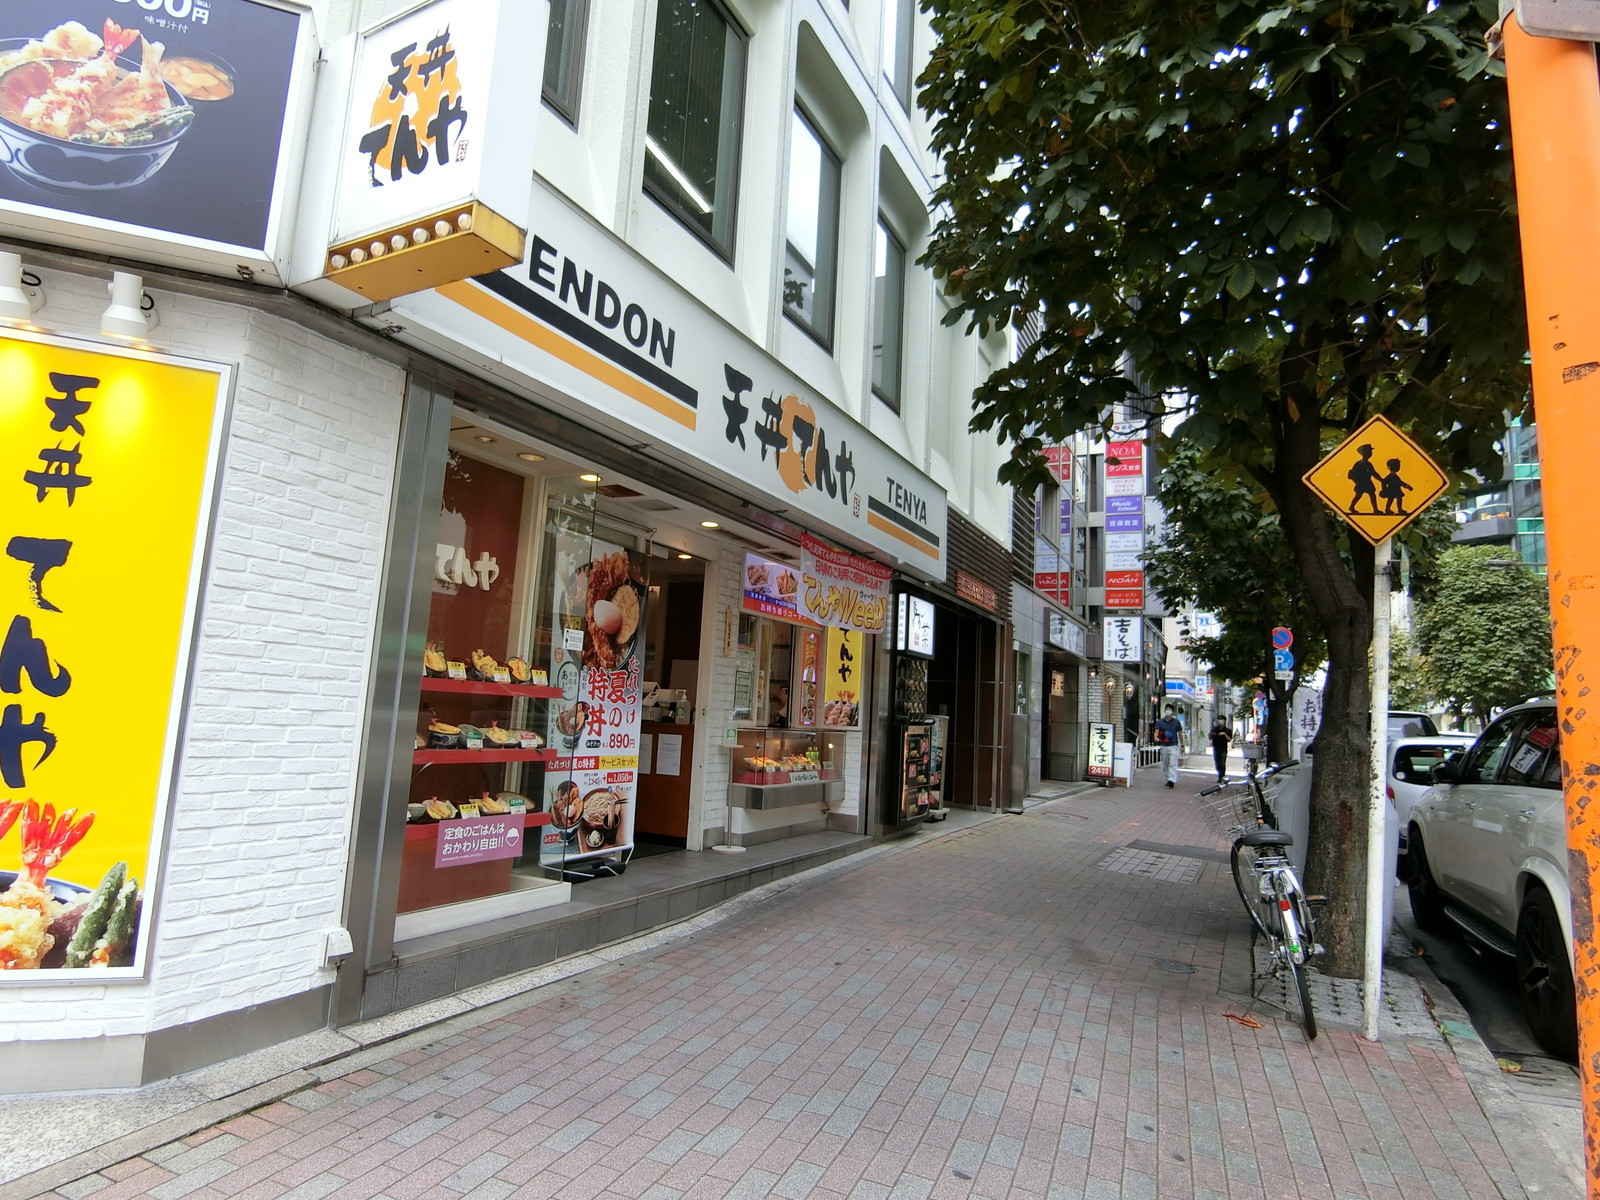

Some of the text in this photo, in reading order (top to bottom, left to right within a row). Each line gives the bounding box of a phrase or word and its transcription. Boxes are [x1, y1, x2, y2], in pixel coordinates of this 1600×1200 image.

[144, 15, 189, 33] 味噌汁付
[359, 95, 468, 187] てんや
[529, 234, 675, 368] ENDON
[1110, 447, 1135, 456] NOA
[886, 476, 927, 525] TENYA
[435, 543, 500, 591] てんや
[1108, 576, 1138, 584] NOAH
[1114, 618, 1133, 659] 吉そば
[0, 535, 73, 788] てんや
[1275, 655, 1284, 670] P
[587, 667, 609, 737] 特丼
[607, 670, 627, 728] 夏の
[626, 655, 640, 725] たれづけ
[609, 733, 636, 749] 890円
[1094, 727, 1110, 764] 吉そば
[601, 757, 636, 767] サービスセット
[442, 836, 505, 855] おかわり自由!!
[443, 822, 505, 840] 定食のごはんは
